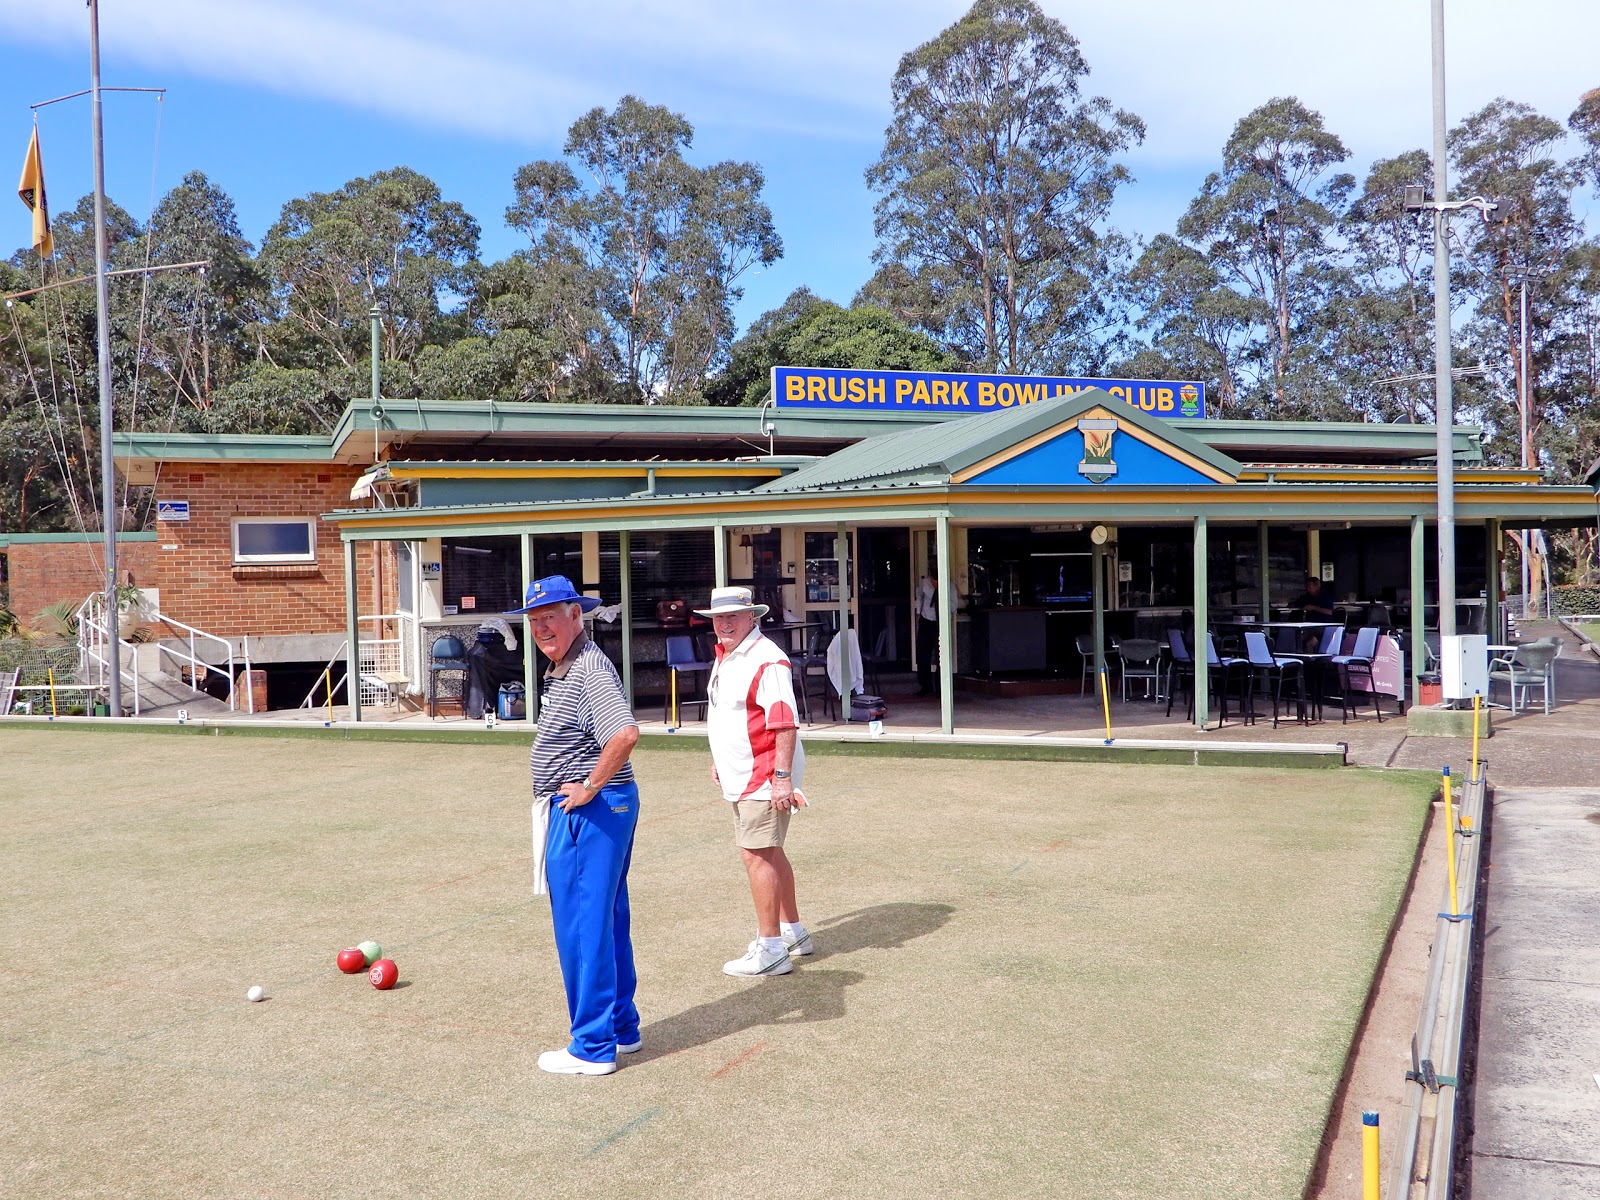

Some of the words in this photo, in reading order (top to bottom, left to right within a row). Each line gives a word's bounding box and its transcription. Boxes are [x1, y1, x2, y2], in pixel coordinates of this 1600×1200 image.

[785, 375, 885, 403] BRUSH
[895, 379, 970, 406] PARK
[978, 382, 1096, 407] BOWLI
[180, 710, 186, 719] 5
[487, 714, 494, 725] 6
[871, 721, 879, 732] 7
